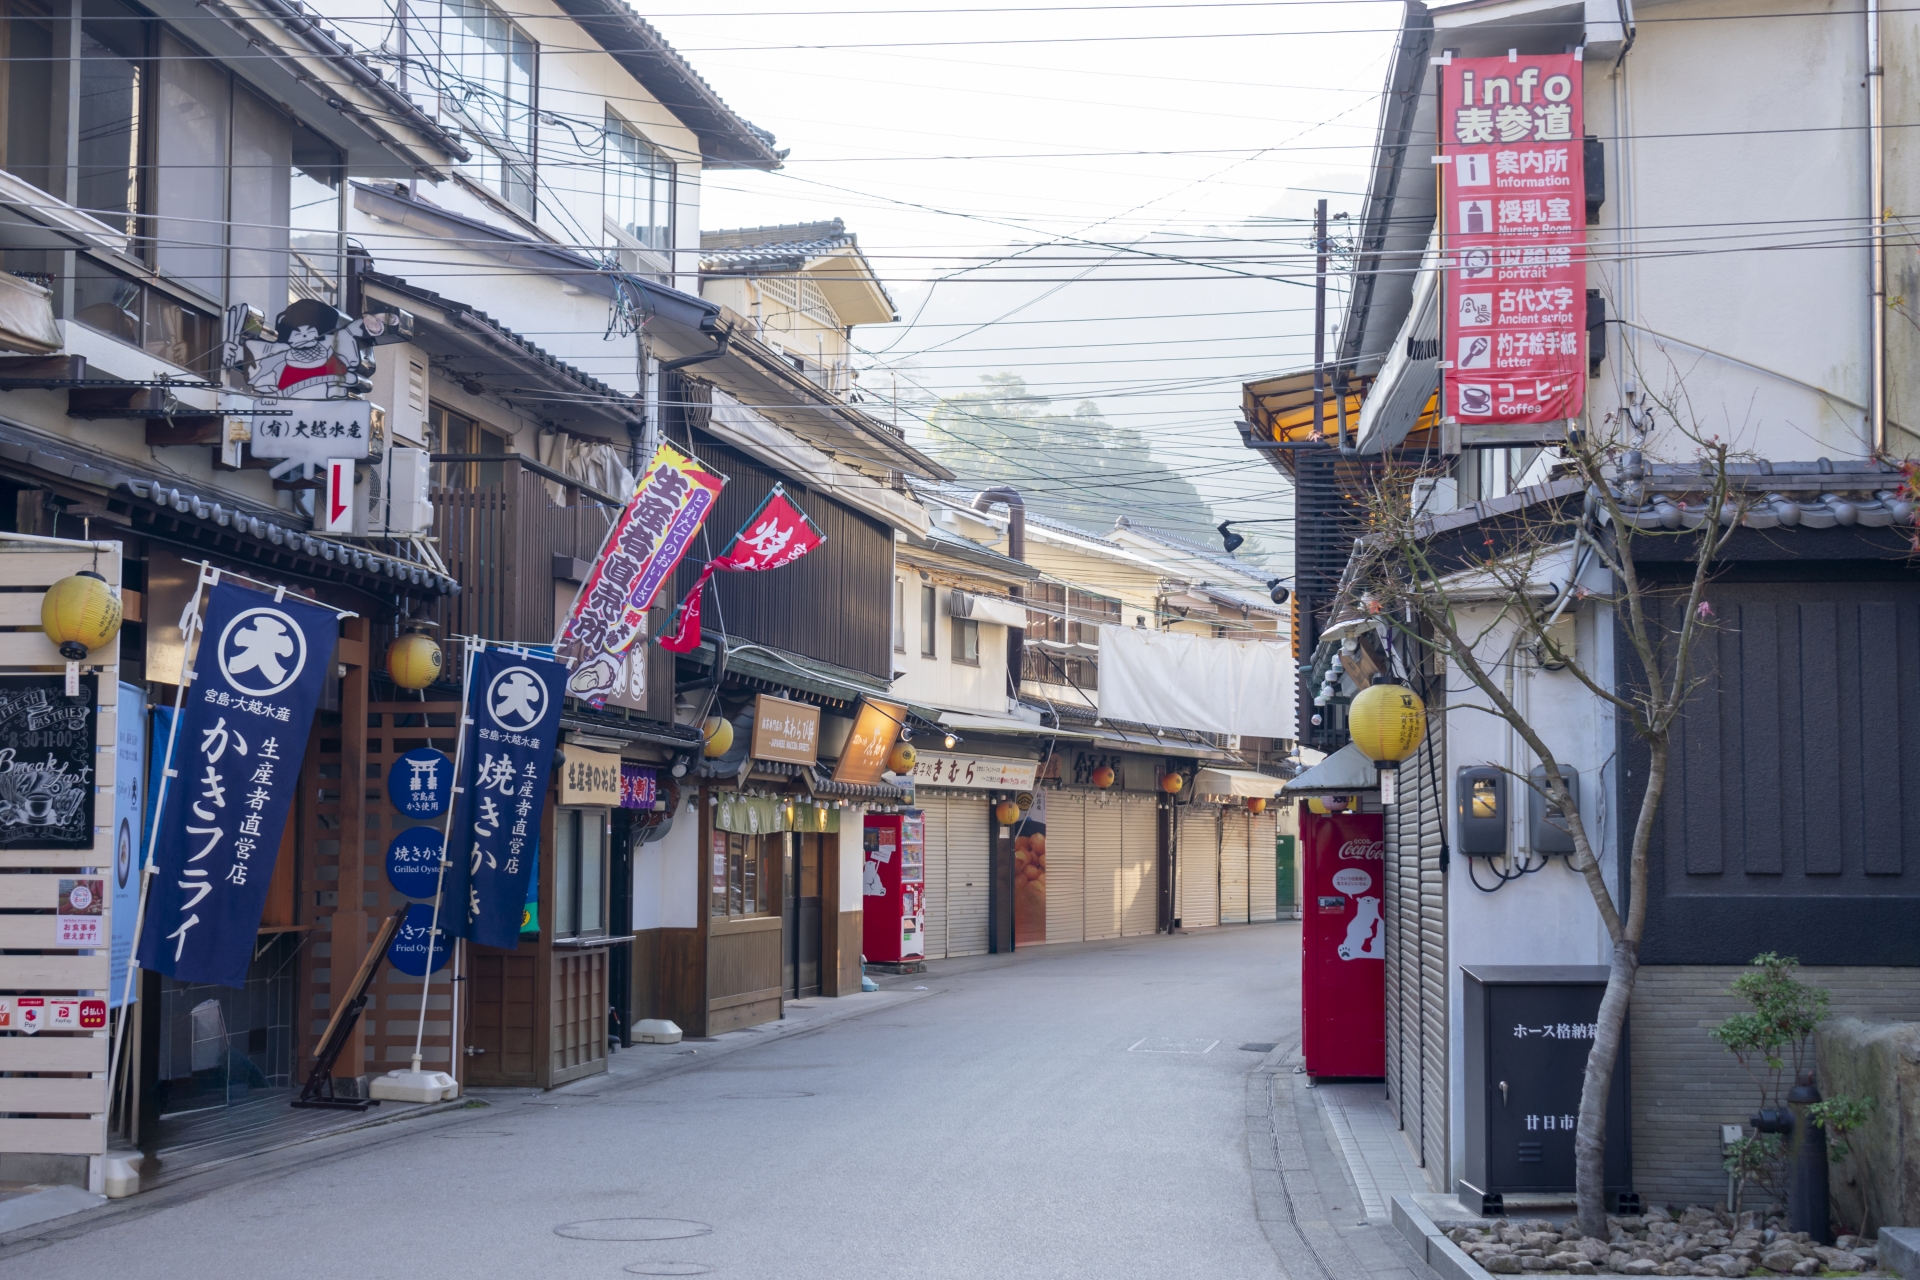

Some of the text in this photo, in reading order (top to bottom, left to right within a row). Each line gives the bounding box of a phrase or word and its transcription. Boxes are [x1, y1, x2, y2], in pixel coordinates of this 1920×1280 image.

[1464, 68, 1571, 105] info
[1457, 103, 1572, 143] 表参道
[1496, 148, 1568, 174] 案内所
[1496, 175, 1570, 188] Information
[1498, 197, 1572, 223] 授乳室
[1498, 223, 1572, 237] Nursing Room
[1499, 245, 1571, 269] 似顔絵
[1499, 267, 1547, 281] portrait
[1499, 287, 1573, 312] 古代文字
[1498, 311, 1573, 325] Ancient script
[1497, 331, 1577, 357] 杓子絵手紙
[1497, 357, 1533, 368] letter
[1498, 380, 1569, 402] コーヒー
[1499, 403, 1542, 415] Coffee
[260, 420, 362, 439] (有)大越水産
[574, 463, 689, 652] 生産者直売所
[635, 493, 706, 602] とれたてのおいしさ
[1, 694, 39, 718] FRESH
[204, 688, 291, 722] 宮島・大越水産
[32, 707, 83, 729] PASTRIES
[479, 728, 541, 750] 宮島・大越水産
[568, 761, 617, 793] 生産者のお店
[933, 758, 976, 785] きむら
[406, 802, 439, 811] かき使用
[411, 791, 437, 801] 宮島産
[225, 736, 281, 885] 生産者直営店
[503, 762, 538, 874] 生産者直営店
[166, 717, 248, 962] かきフライ
[394, 865, 419, 873] Grilled
[63, 923, 97, 931] お食事券
[63, 932, 97, 940] 使えます!
[396, 944, 415, 952] Fried
[82, 1006, 104, 1016] d払い
[24, 1021, 36, 1029] Pay
[1513, 1023, 1599, 1039] ホース格納箱
[1524, 1114, 1579, 1130] 廿日市
